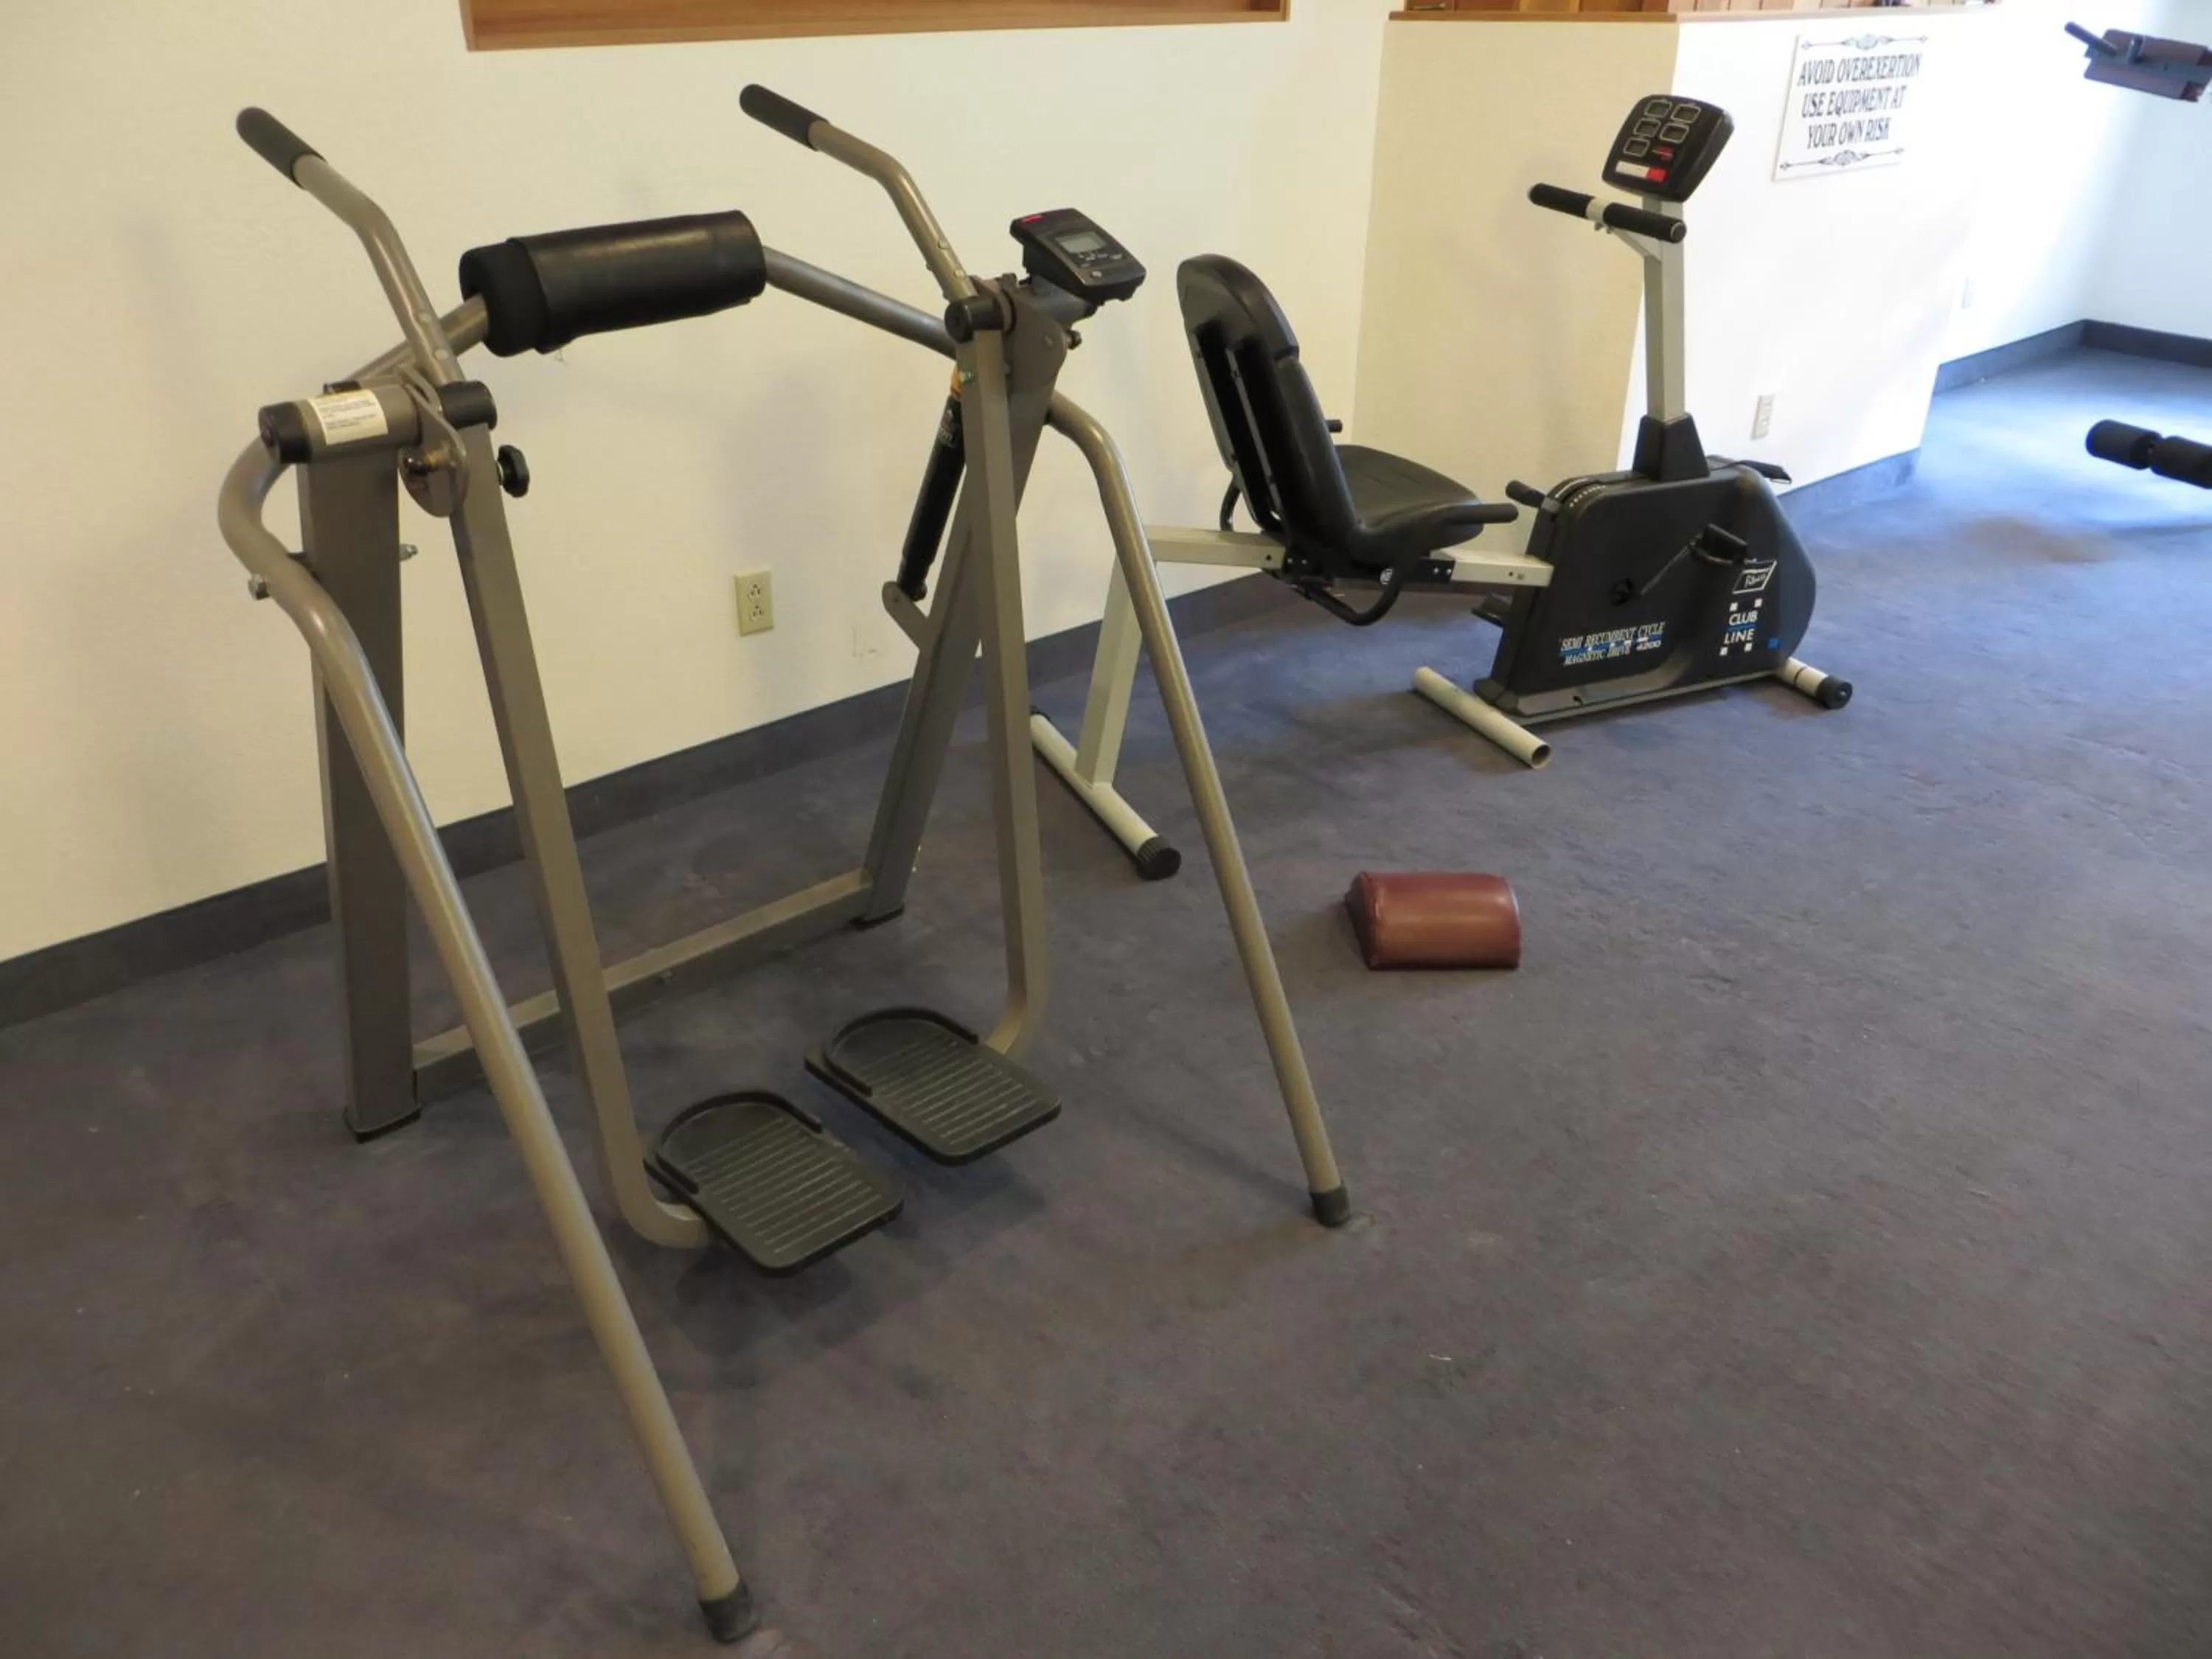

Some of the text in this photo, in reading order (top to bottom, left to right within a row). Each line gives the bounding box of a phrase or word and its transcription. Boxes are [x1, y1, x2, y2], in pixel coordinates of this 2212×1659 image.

[1798, 53, 1922, 86] AVOID OVEREXERTION
[1801, 85, 1907, 118] USE EQUIPMENT AT
[1807, 117, 1891, 149] YOUR OWN RISK
[1729, 610, 1758, 626] CLUB
[1638, 622, 1666, 640] CYCLE
[1725, 628, 1755, 644] LINE
